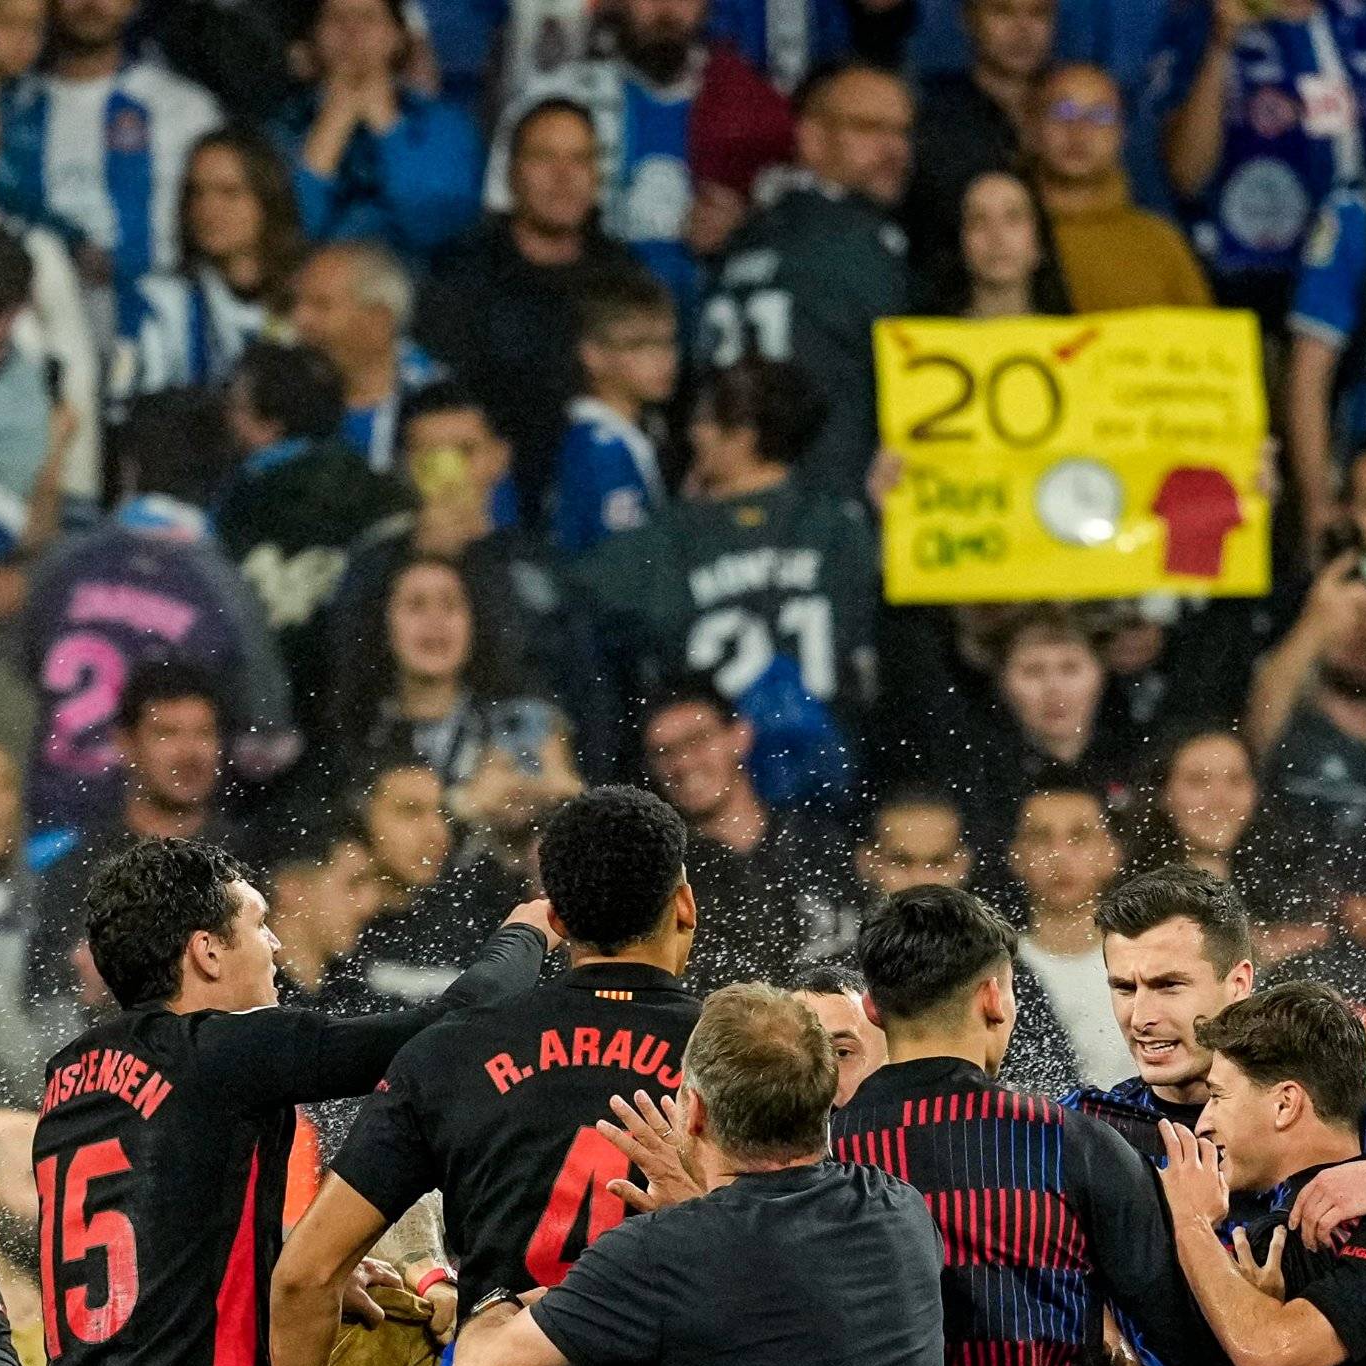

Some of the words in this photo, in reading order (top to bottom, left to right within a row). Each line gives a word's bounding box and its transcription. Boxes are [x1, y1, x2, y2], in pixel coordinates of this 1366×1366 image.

[908, 352, 1063, 449] 20
[35, 1137, 139, 1360] 15
[525, 1126, 636, 1288] 4
